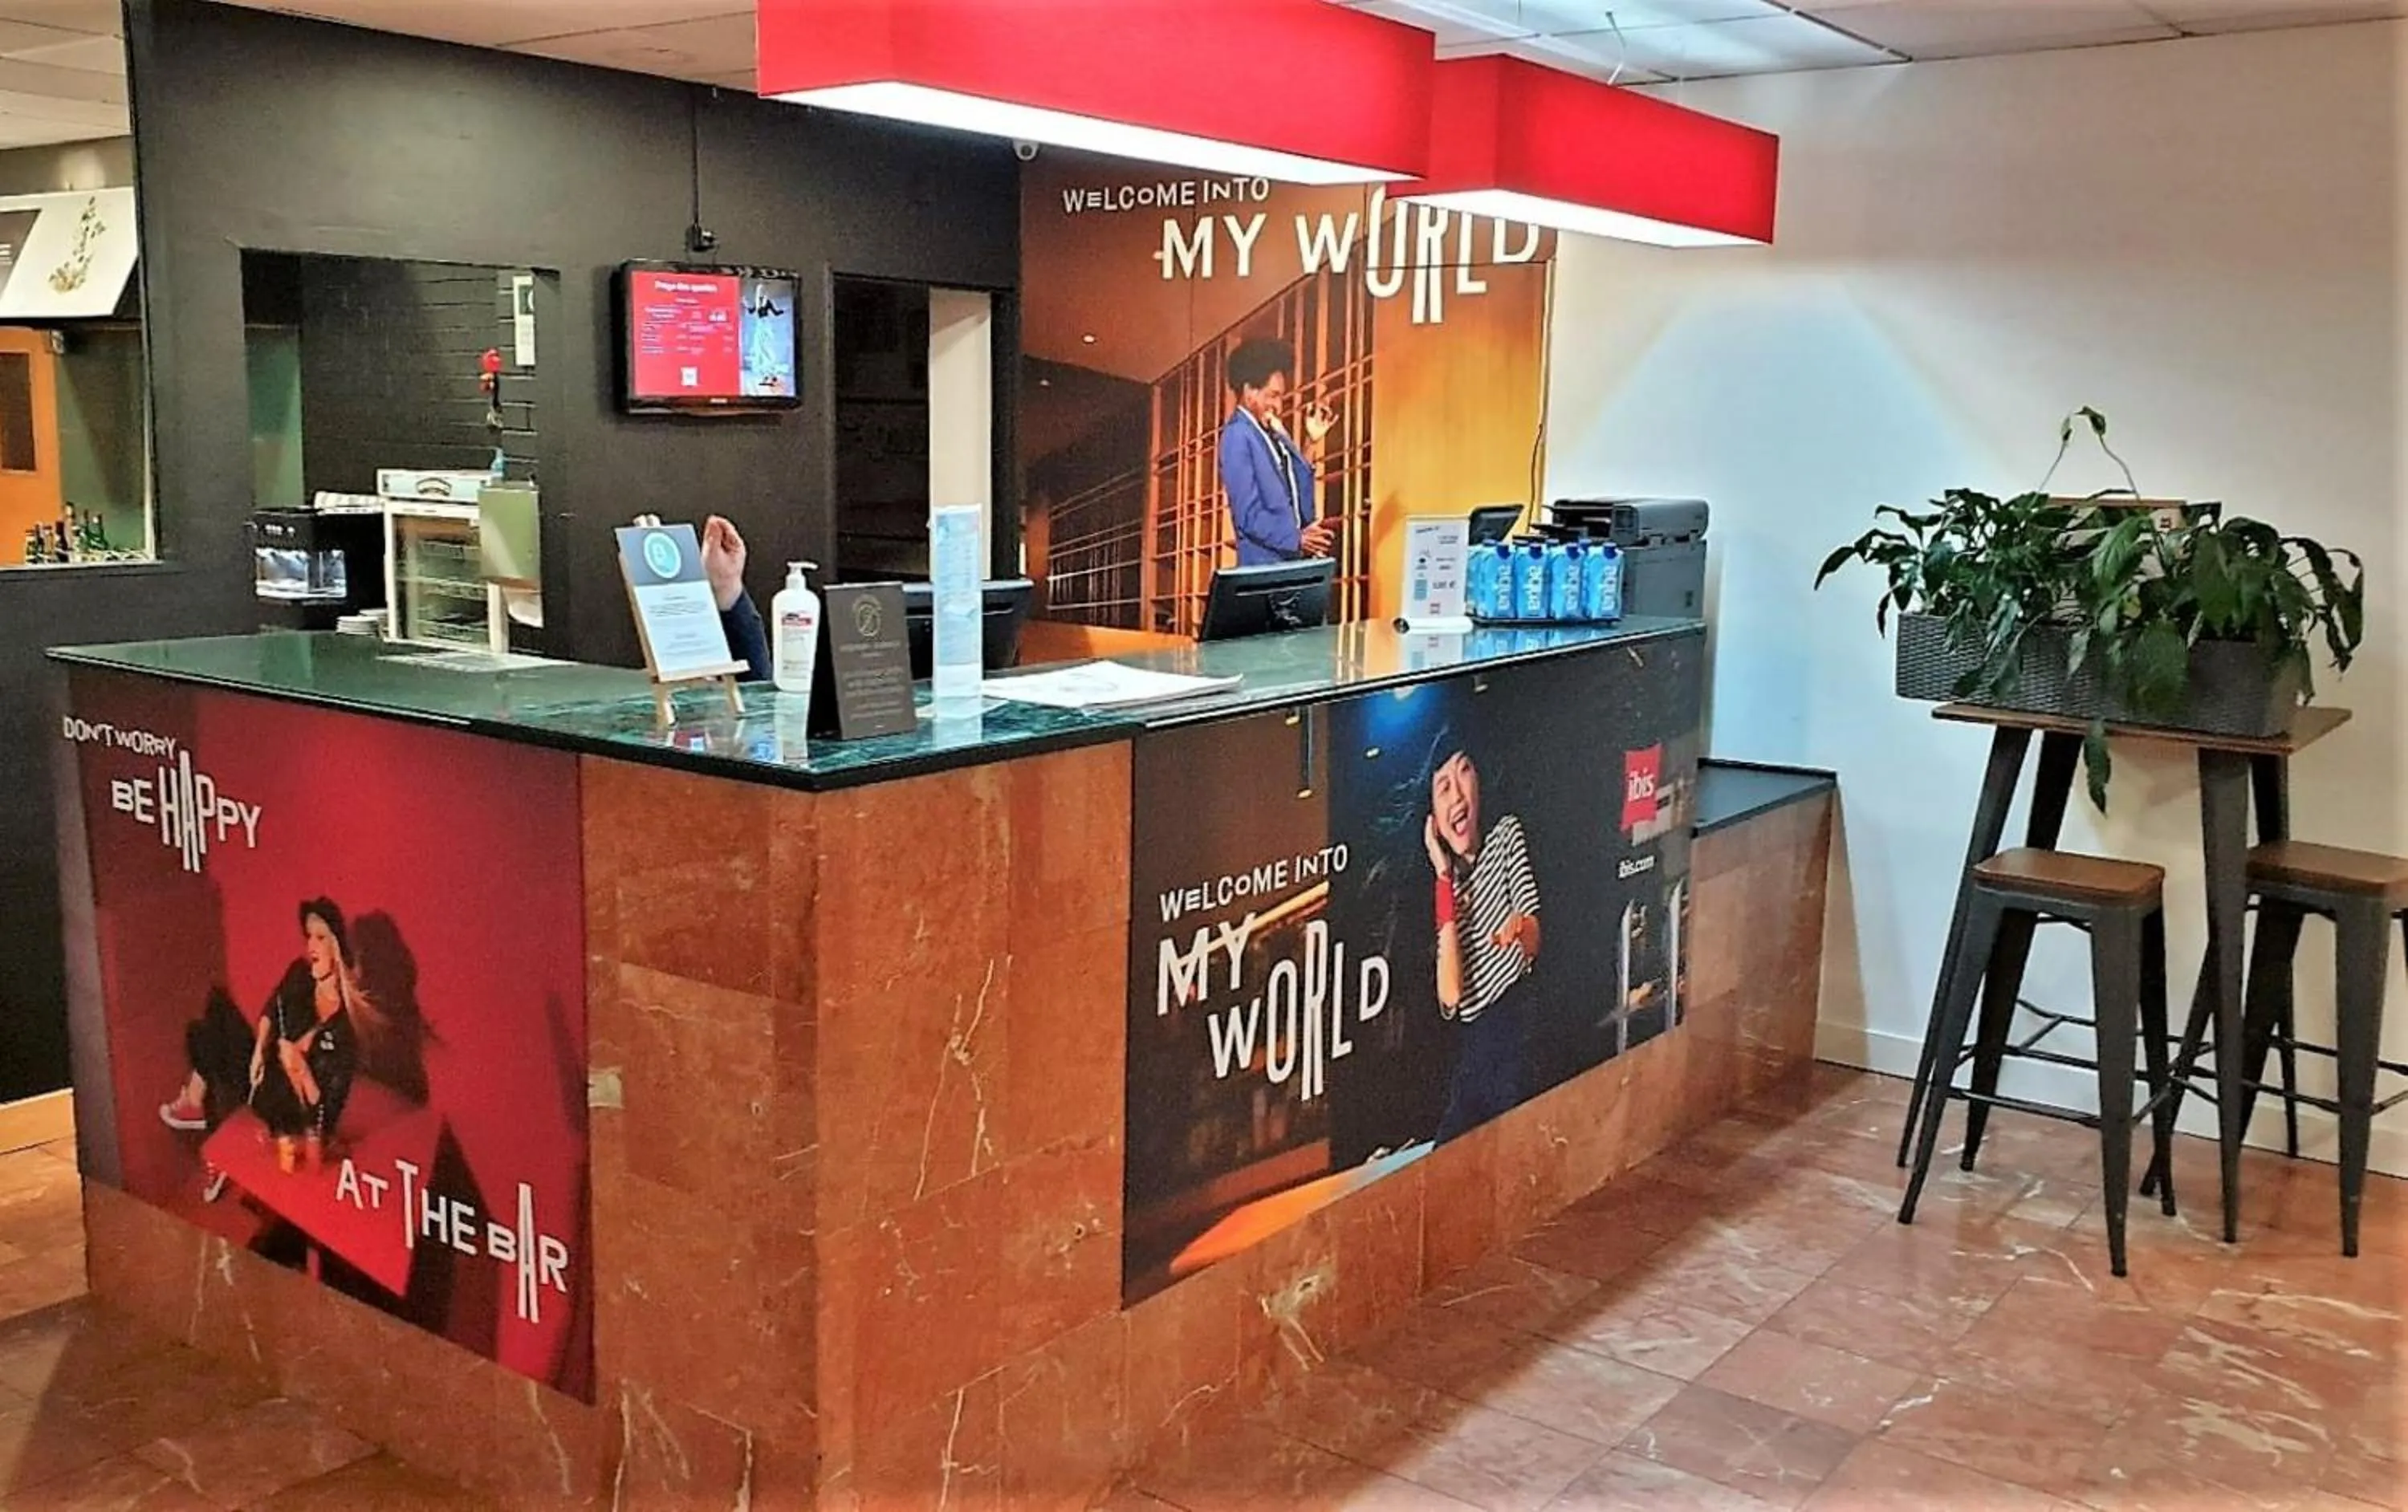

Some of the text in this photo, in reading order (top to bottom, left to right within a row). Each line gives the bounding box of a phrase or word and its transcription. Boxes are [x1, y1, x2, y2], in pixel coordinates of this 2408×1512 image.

[1062, 177, 1270, 213] WELCOME INTO
[1161, 185, 1540, 323] MY WORLD
[114, 730, 177, 761] WORRY
[1627, 766, 1655, 803] ibis
[111, 750, 262, 873] BE HAPPY
[1160, 843, 1348, 923] WELCOME INTO
[1617, 854, 1655, 879] ibis.com
[1157, 911, 1257, 1018] MY
[1206, 920, 1390, 1102] WORLD
[336, 1158, 568, 1324] AT THE BAR
